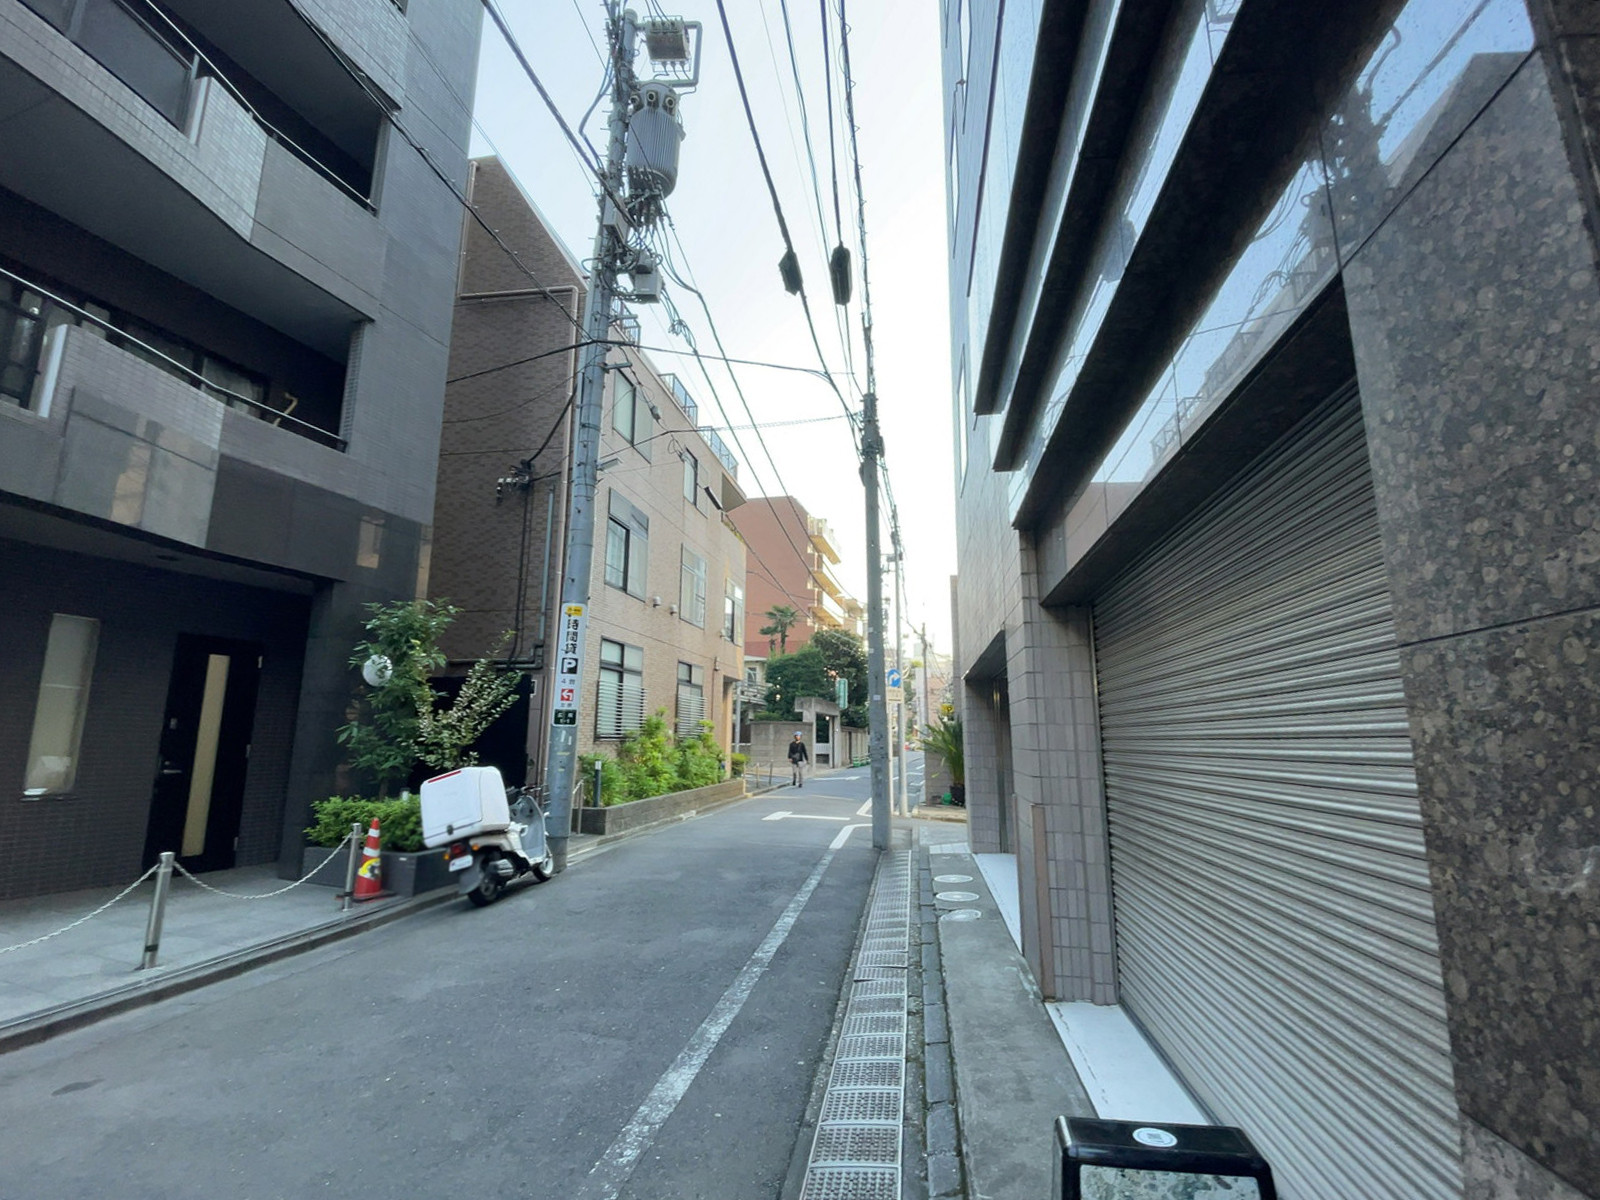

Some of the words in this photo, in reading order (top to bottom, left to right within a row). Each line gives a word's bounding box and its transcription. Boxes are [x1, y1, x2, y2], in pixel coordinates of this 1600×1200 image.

[565, 619, 579, 654] 時間貸
[563, 659, 577, 672] P
